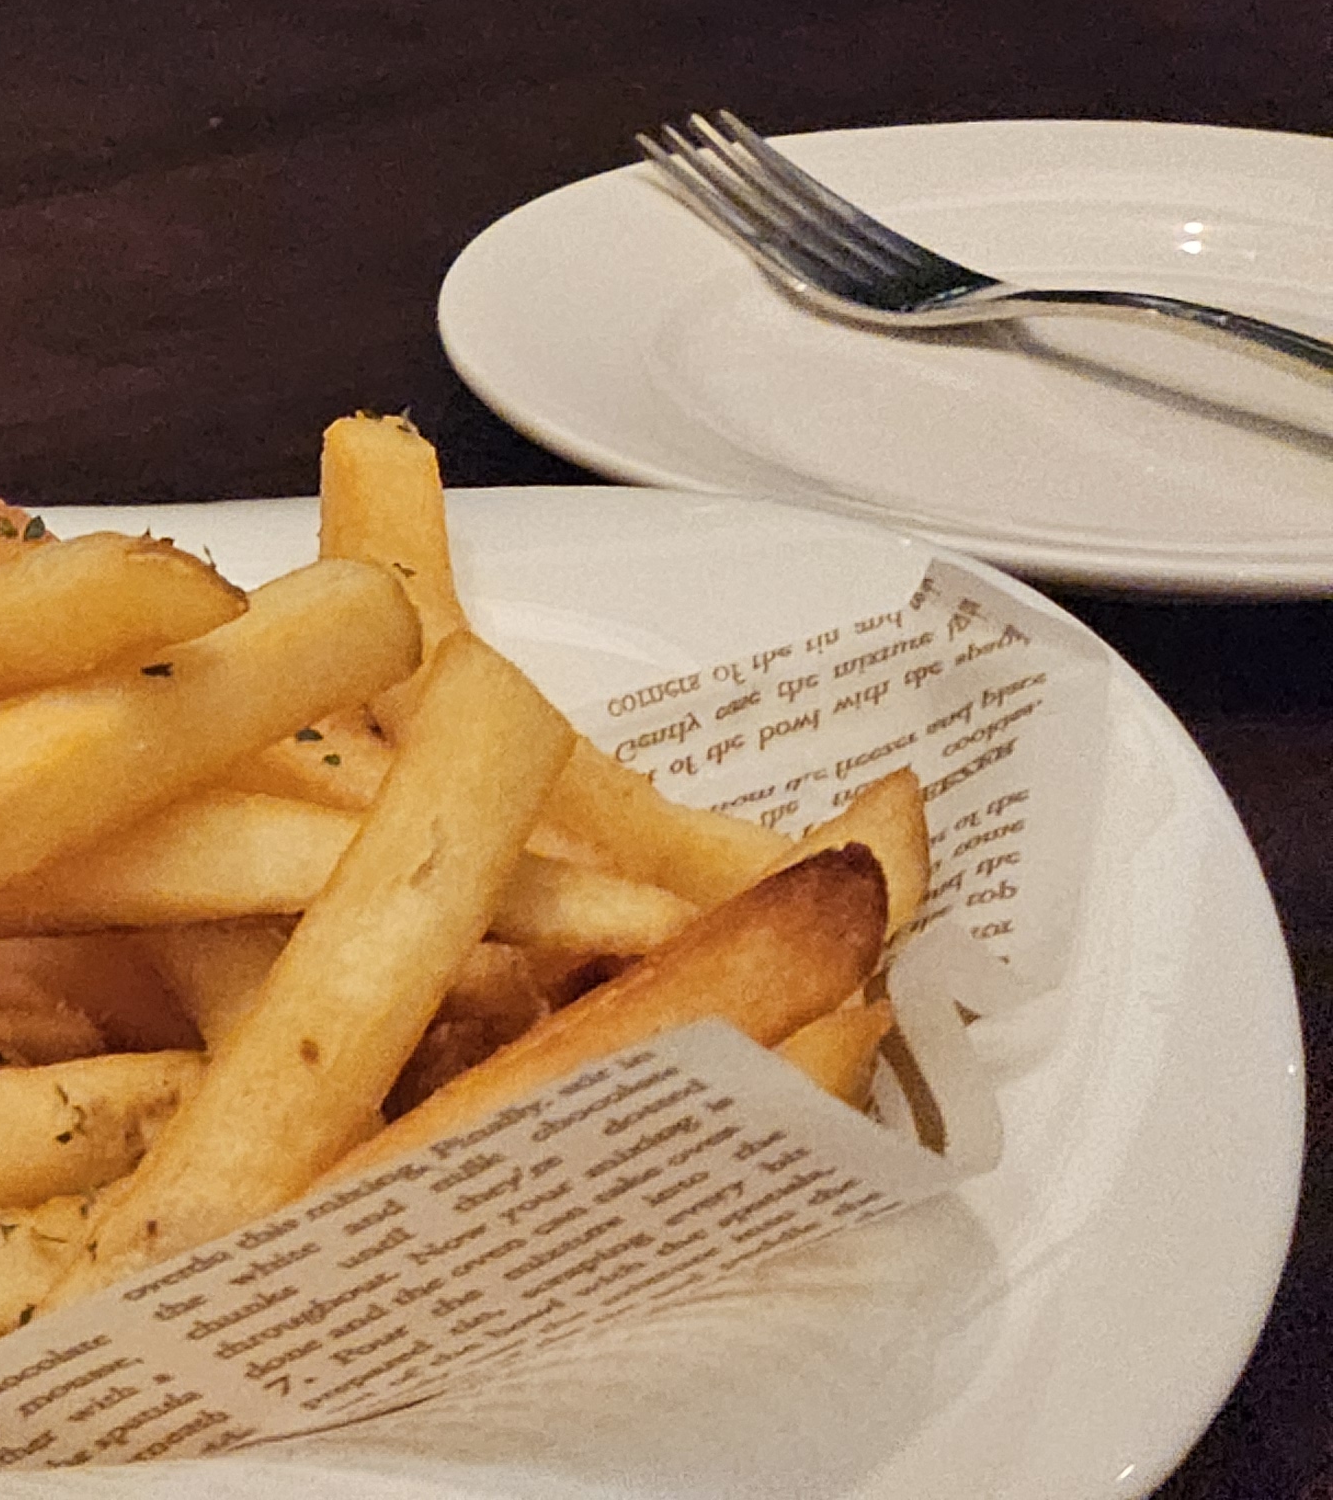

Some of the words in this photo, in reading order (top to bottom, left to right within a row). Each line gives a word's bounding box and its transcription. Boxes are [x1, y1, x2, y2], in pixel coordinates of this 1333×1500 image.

[153, 1294, 208, 1322] the
[228, 1242, 321, 1286] white
[343, 1198, 407, 1236] and
[530, 1066, 680, 1143] chocolate
[406, 1223, 487, 1266] Now
[498, 1181, 573, 1226] your
[185, 1285, 300, 1341] chunks
[244, 1339, 324, 1381] done
[328, 1303, 390, 1340] and
[391, 1277, 445, 1307] the
[451, 1238, 527, 1277] oven
[532, 1206, 589, 1236] can
[328, 1324, 409, 1367] Pour
[430, 1289, 484, 1318] the
